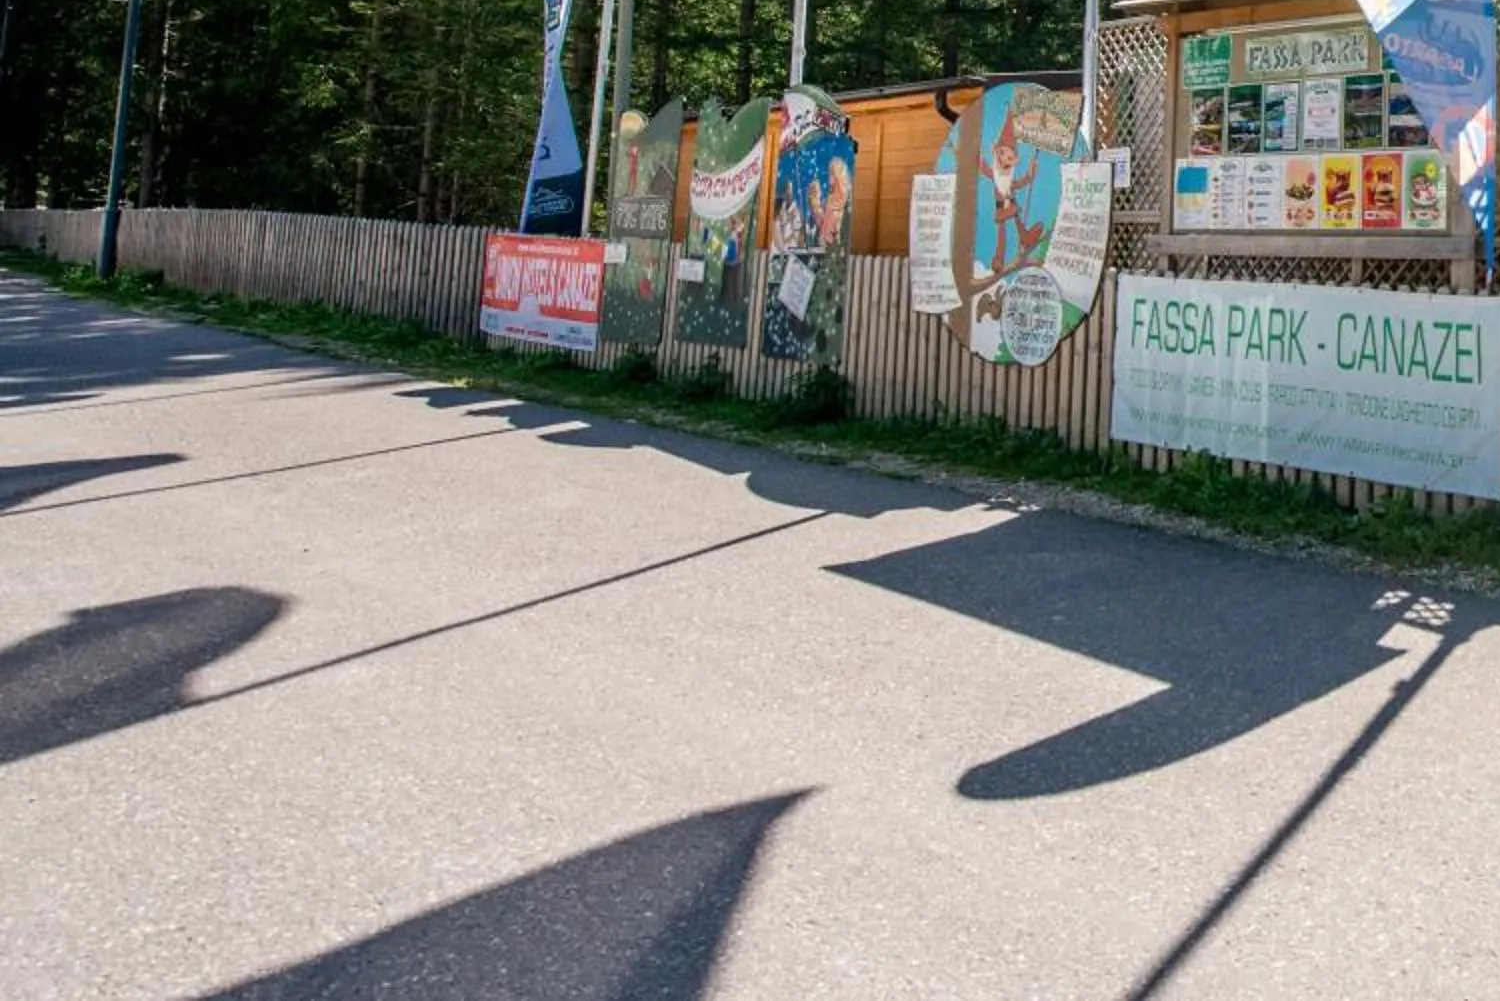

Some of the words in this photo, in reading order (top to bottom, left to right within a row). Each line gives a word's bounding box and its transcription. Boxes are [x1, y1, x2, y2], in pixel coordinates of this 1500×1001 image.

[1248, 40, 1303, 73] FASSA
[1130, 298, 1216, 357] FASSA
[1226, 303, 1309, 366] PARK
[1336, 312, 1484, 386] CANAZEI
